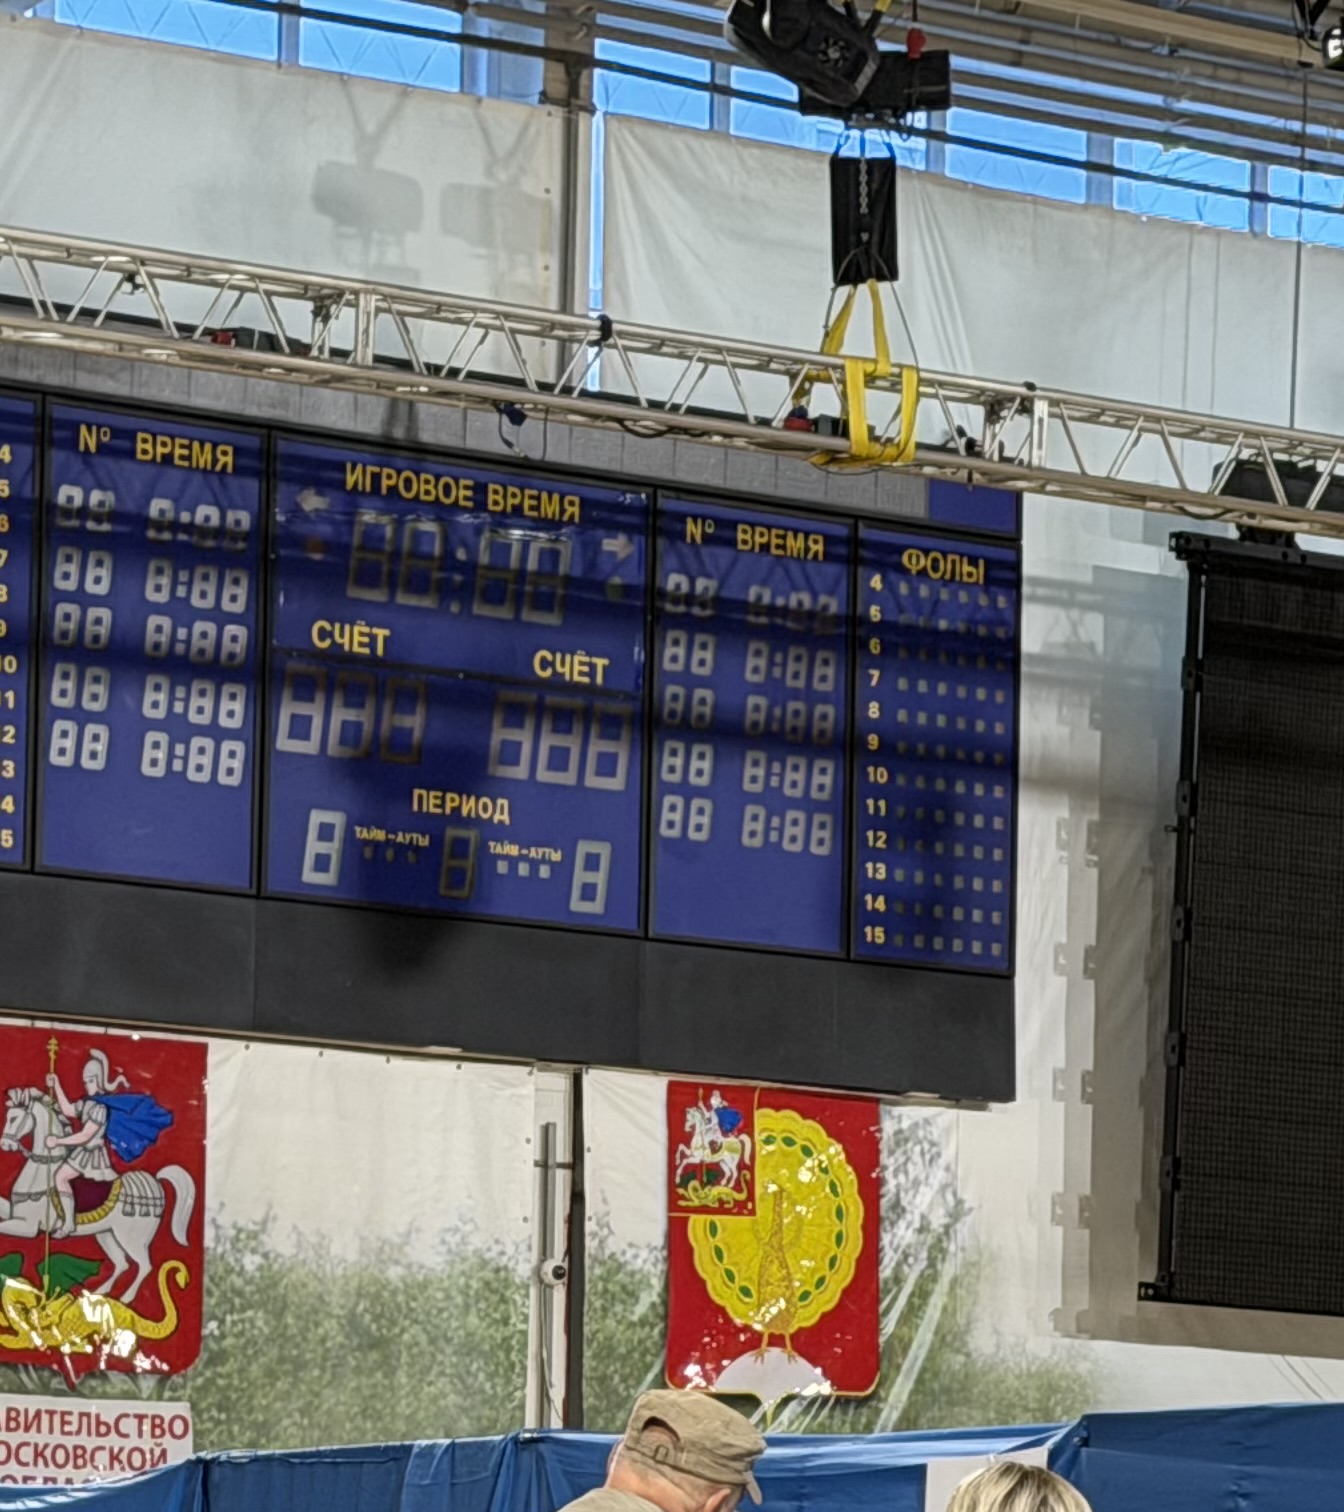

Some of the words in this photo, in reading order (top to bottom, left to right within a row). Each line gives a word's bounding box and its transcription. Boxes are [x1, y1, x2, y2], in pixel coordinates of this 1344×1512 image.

[135, 432, 234, 475] ВРЕМЯ
[344, 463, 474, 509] ИГРОВОЕ
[487, 483, 581, 522] ВРЕМЯ
[737, 524, 825, 561] ВРЕМЯ
[902, 549, 986, 584] ФОЛЫ
[869, 575, 882, 592] 4
[869, 606, 881, 622] 5
[311, 620, 390, 657] СЧЁТ
[869, 638, 881, 654] 6
[533, 649, 609, 685] СЧЁТ
[868, 670, 880, 686] 7
[868, 701, 880, 718] 8
[867, 733, 880, 751] 9
[867, 766, 888, 784] 10
[412, 788, 510, 824] ПЕРИОД
[867, 798, 886, 815] 11
[866, 831, 887, 848] 12
[865, 863, 886, 880] 13
[865, 894, 886, 912] 14
[864, 926, 885, 944] 15
